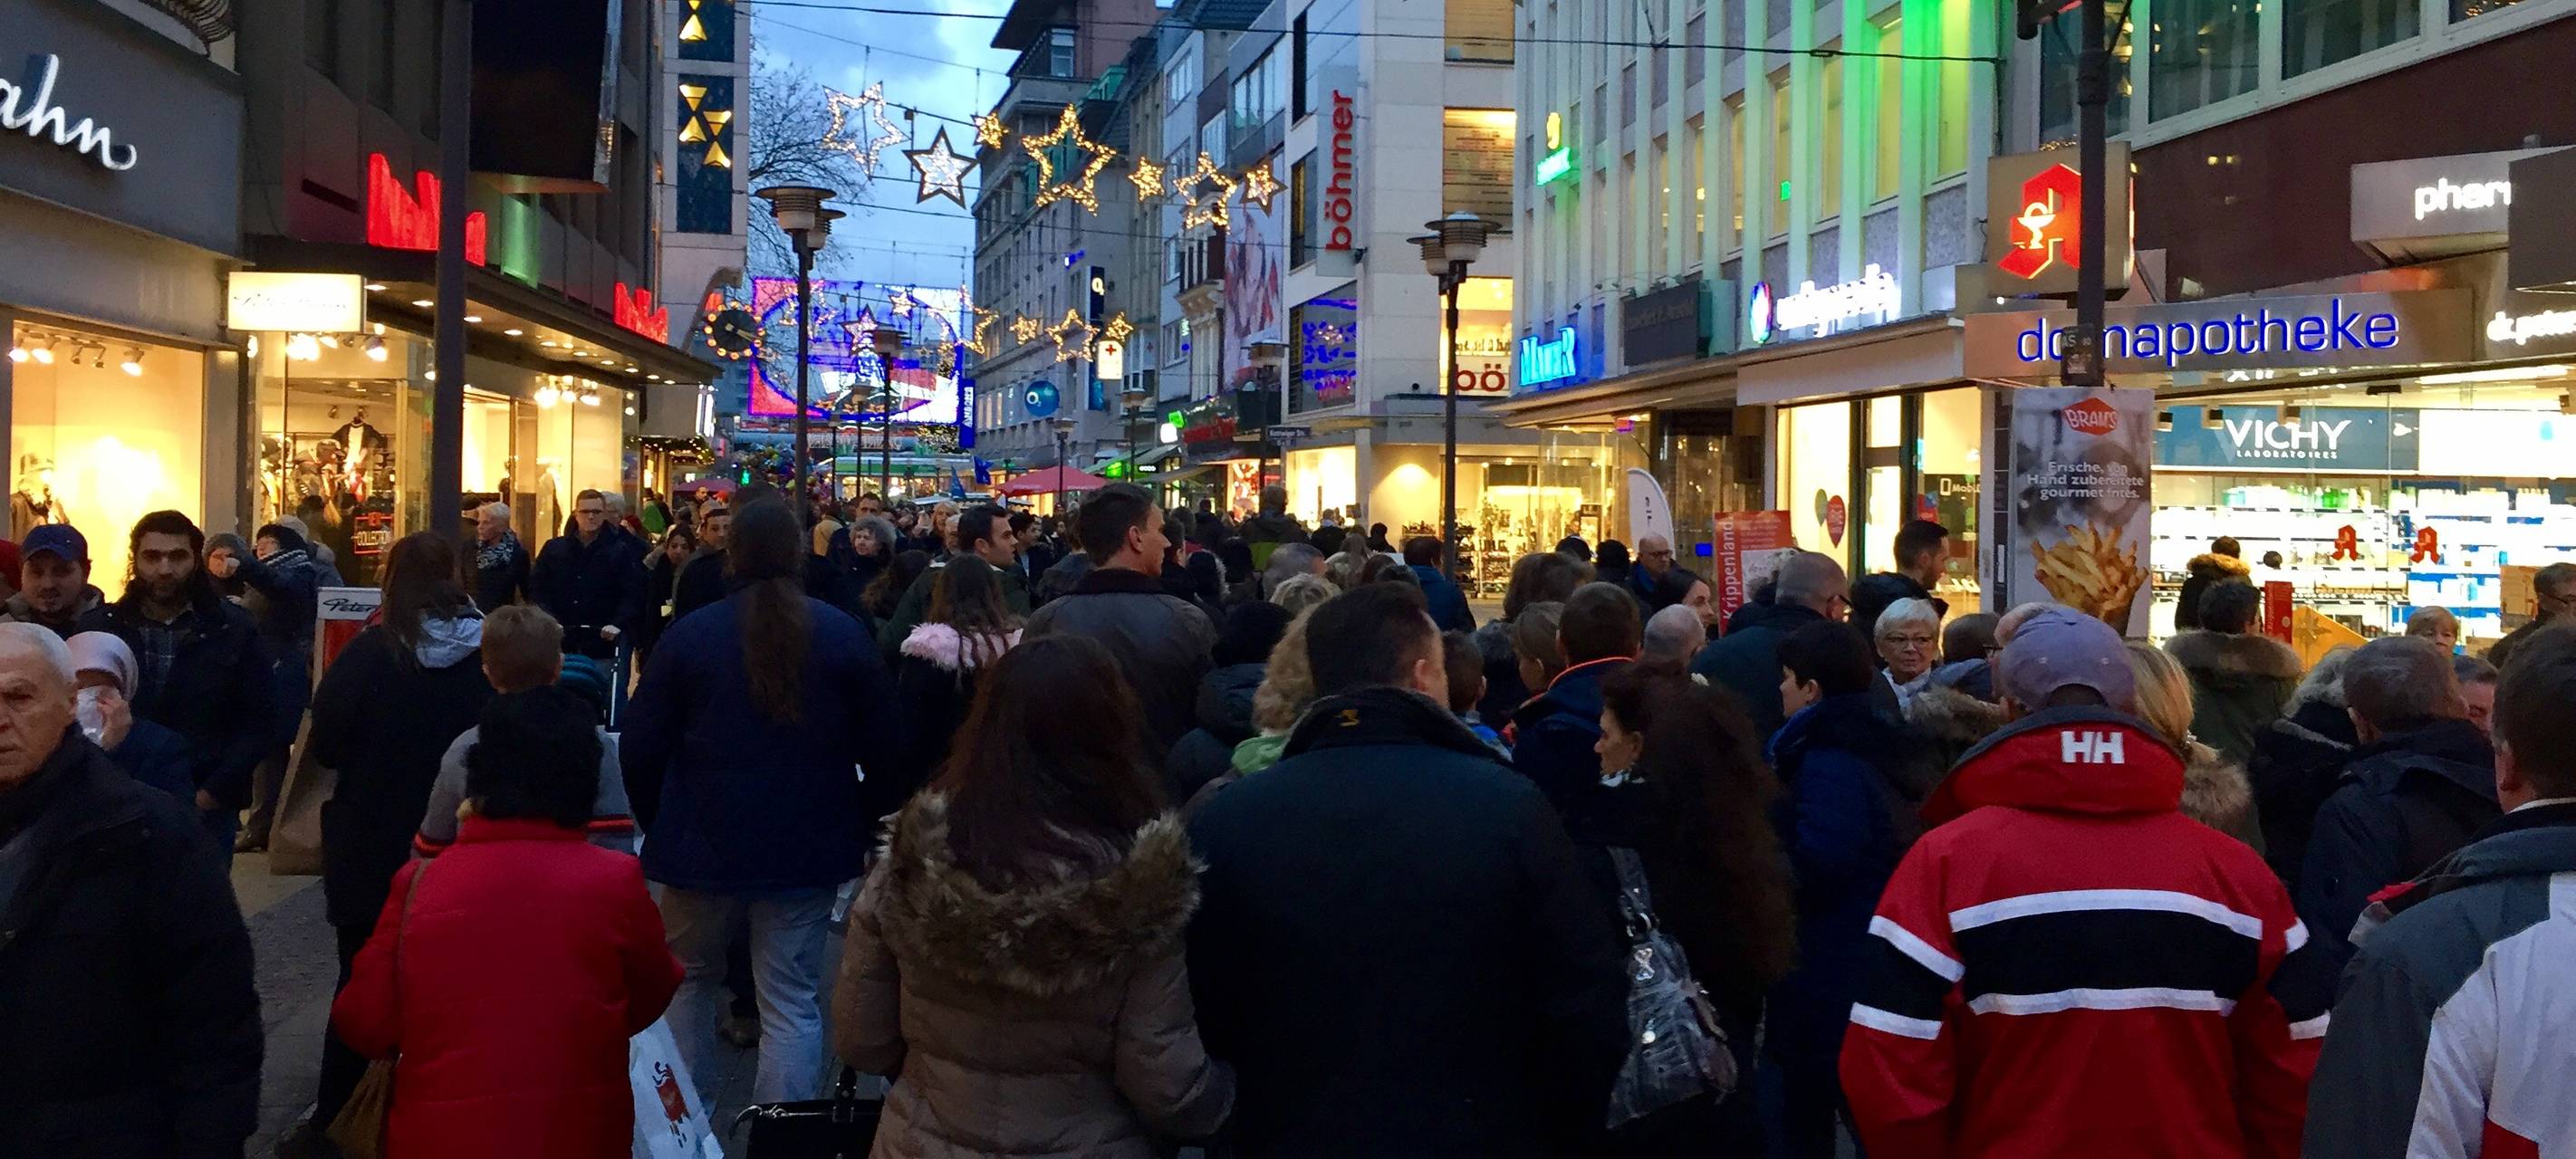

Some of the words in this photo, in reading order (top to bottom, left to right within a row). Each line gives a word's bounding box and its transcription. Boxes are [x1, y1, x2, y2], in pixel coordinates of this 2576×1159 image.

[1324, 89, 1353, 251] böhmer
[2225, 420, 2352, 450] VICHY
[2236, 450, 2338, 459] LABORATOIRES
[2048, 462, 2104, 474] Frische,
[2027, 474, 2067, 485] Hand
[2071, 474, 2145, 486] zubereitete
[2040, 489, 2103, 501] gourmet
[322, 598, 378, 613] Peter
[2061, 731, 2125, 764] HH
